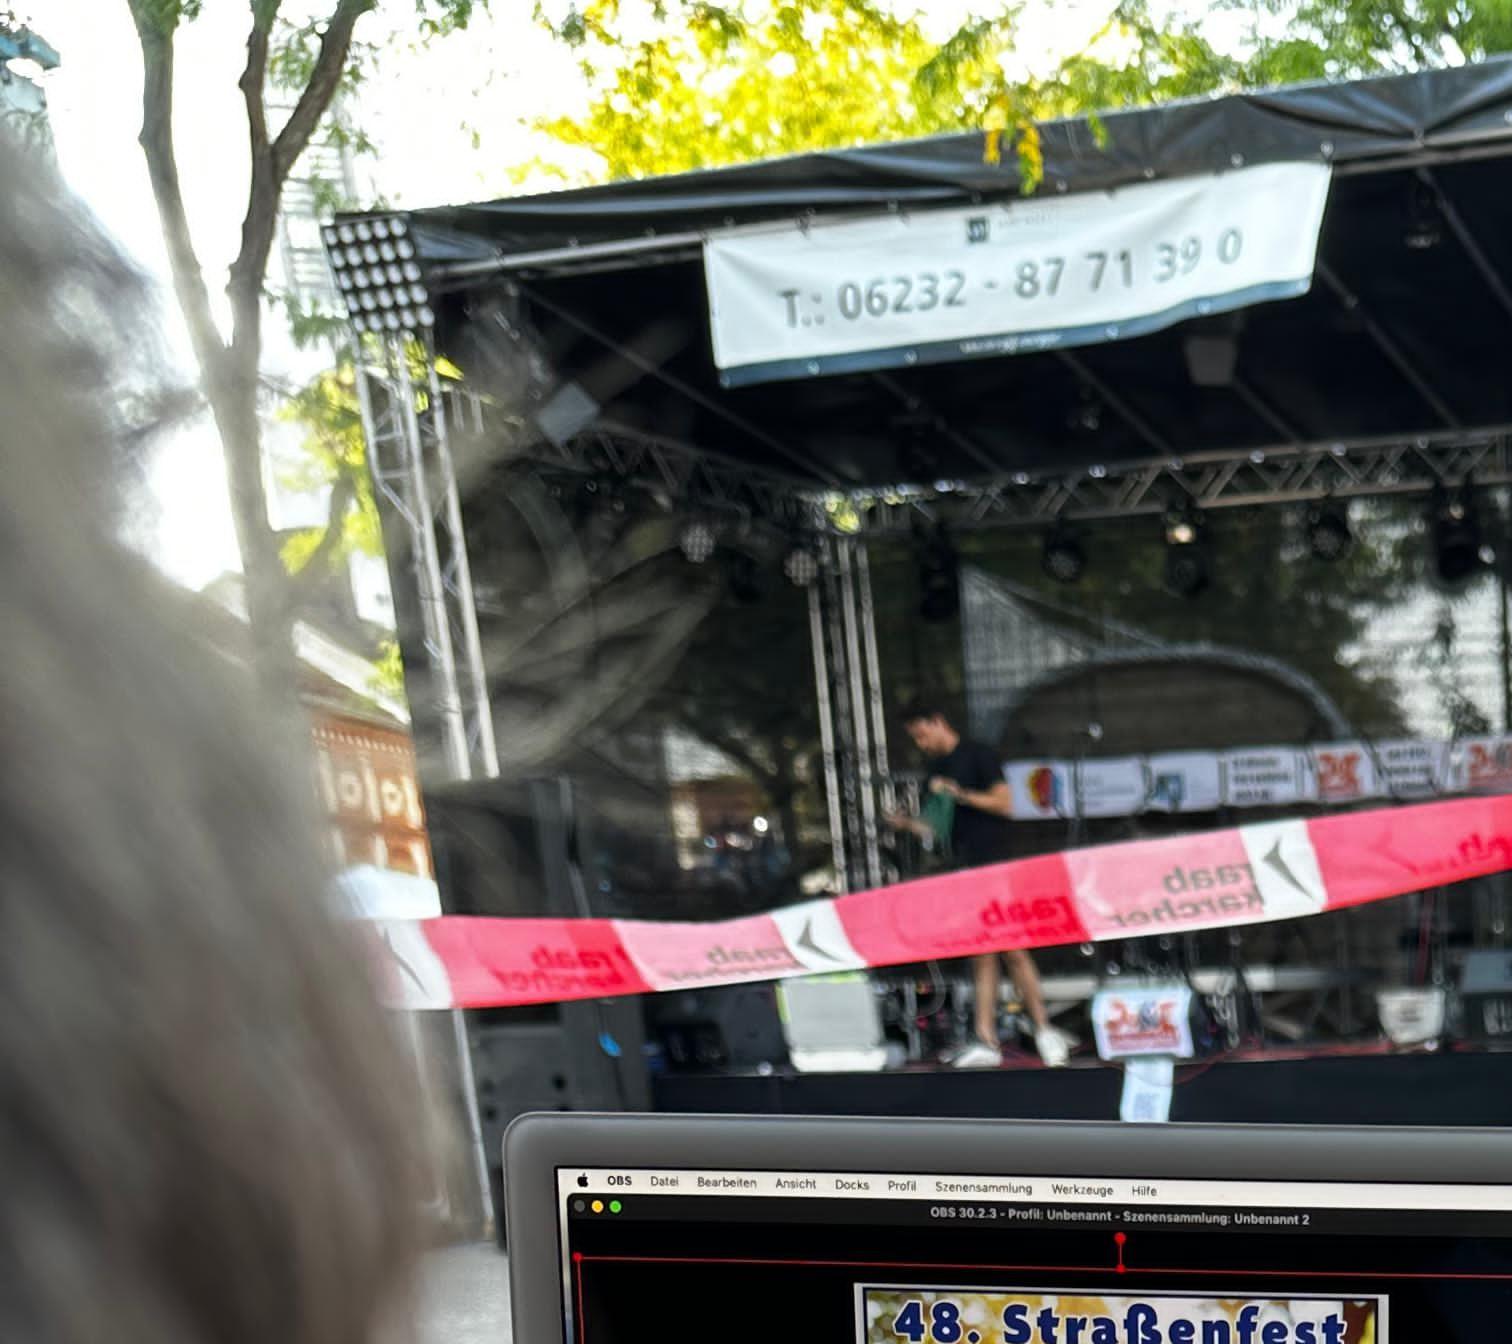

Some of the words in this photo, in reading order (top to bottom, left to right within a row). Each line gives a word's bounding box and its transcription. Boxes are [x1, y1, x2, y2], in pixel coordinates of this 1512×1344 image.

[780, 288, 825, 329] T.:
[837, 270, 967, 320] 06232
[1013, 256, 1066, 297] 87
[1084, 250, 1135, 291] 71
[1153, 235, 1203, 283] 39
[1216, 229, 1243, 265] 0
[607, 1176, 632, 1186] OBS
[651, 1176, 679, 1187] Datei
[698, 1177, 757, 1189] Bearbeiten
[776, 1178, 816, 1189] Ansicht
[835, 1179, 869, 1190] Docks
[888, 1180, 917, 1192] Profil
[935, 1181, 1032, 1195] Szenensammlung
[1051, 1184, 1114, 1197] Werkzeuge
[1132, 1185, 1157, 1196] Hilfe
